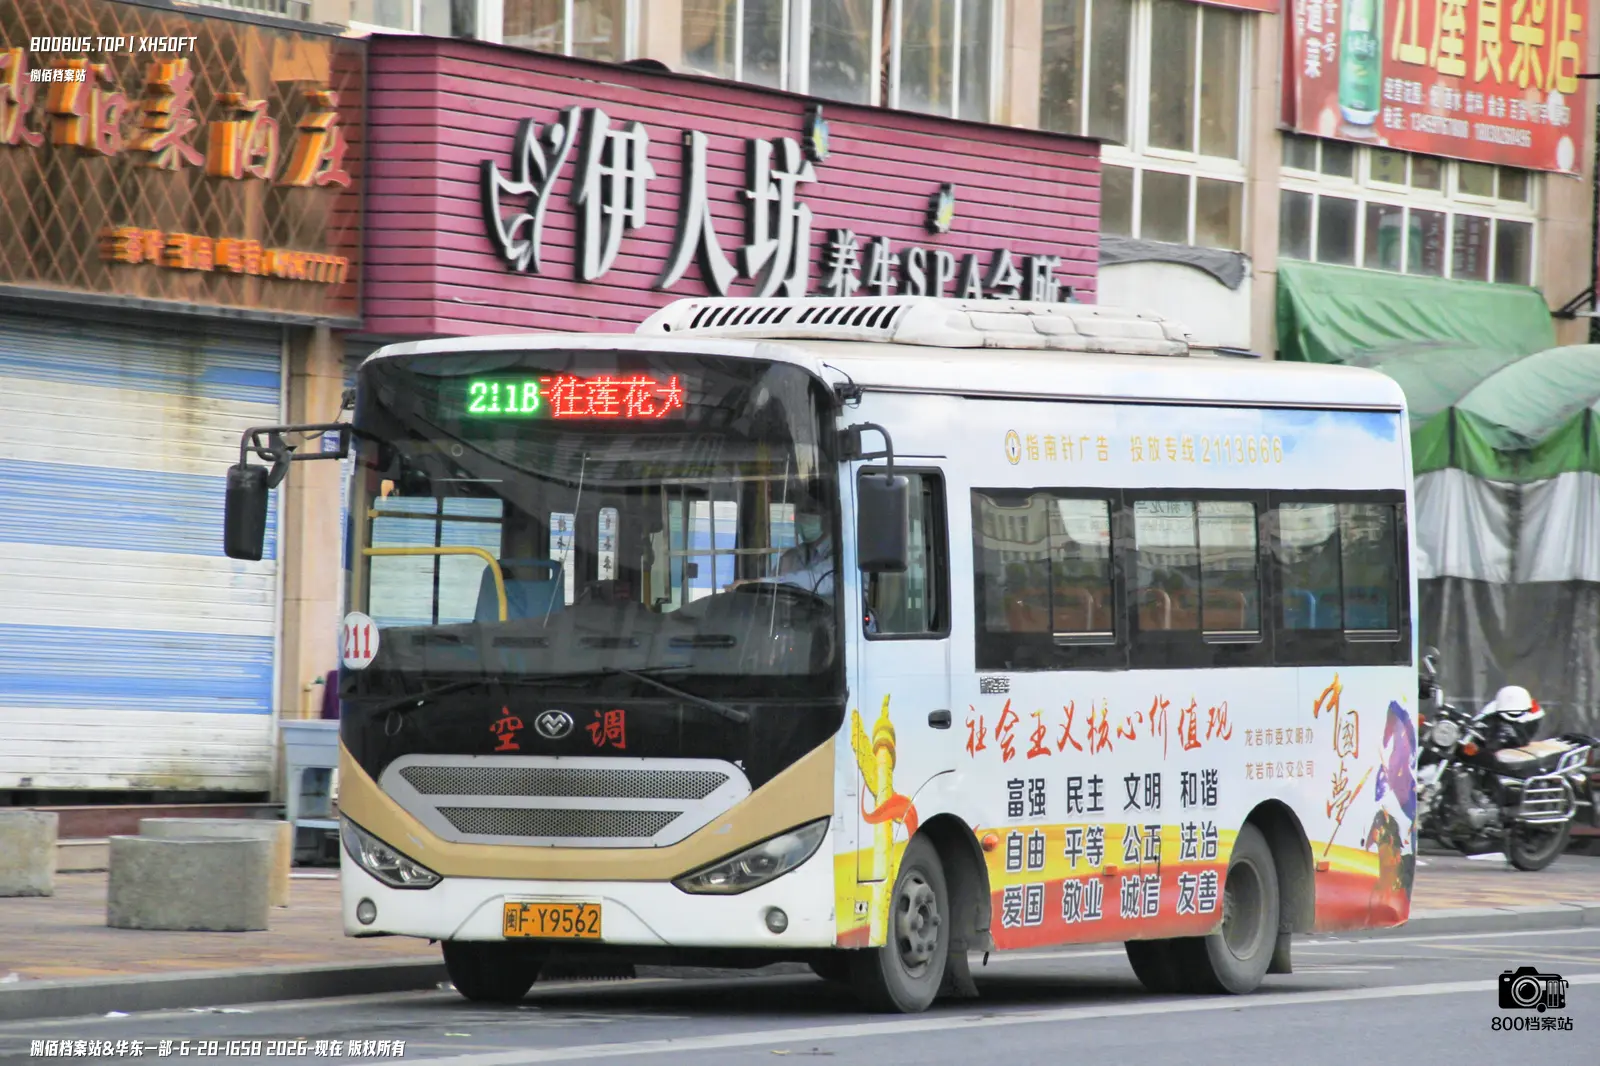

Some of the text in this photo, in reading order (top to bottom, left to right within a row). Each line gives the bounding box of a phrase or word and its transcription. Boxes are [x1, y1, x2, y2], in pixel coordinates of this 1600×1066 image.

[571, 106, 818, 298] 伊人坊
[469, 376, 683, 418] 211B 往莲花大
[1025, 435, 1109, 462] 指南针广告
[343, 623, 372, 659] 211
[1244, 726, 1315, 748] 龙岩市委文明办
[1245, 759, 1316, 781] 龙岩市公交公司
[1006, 769, 1219, 818] 富强 民主 文明 和谐
[1005, 820, 1218, 872] 自由 平等 公正 法治
[1002, 870, 1218, 929] 爱国 敬业 诚信 友善
